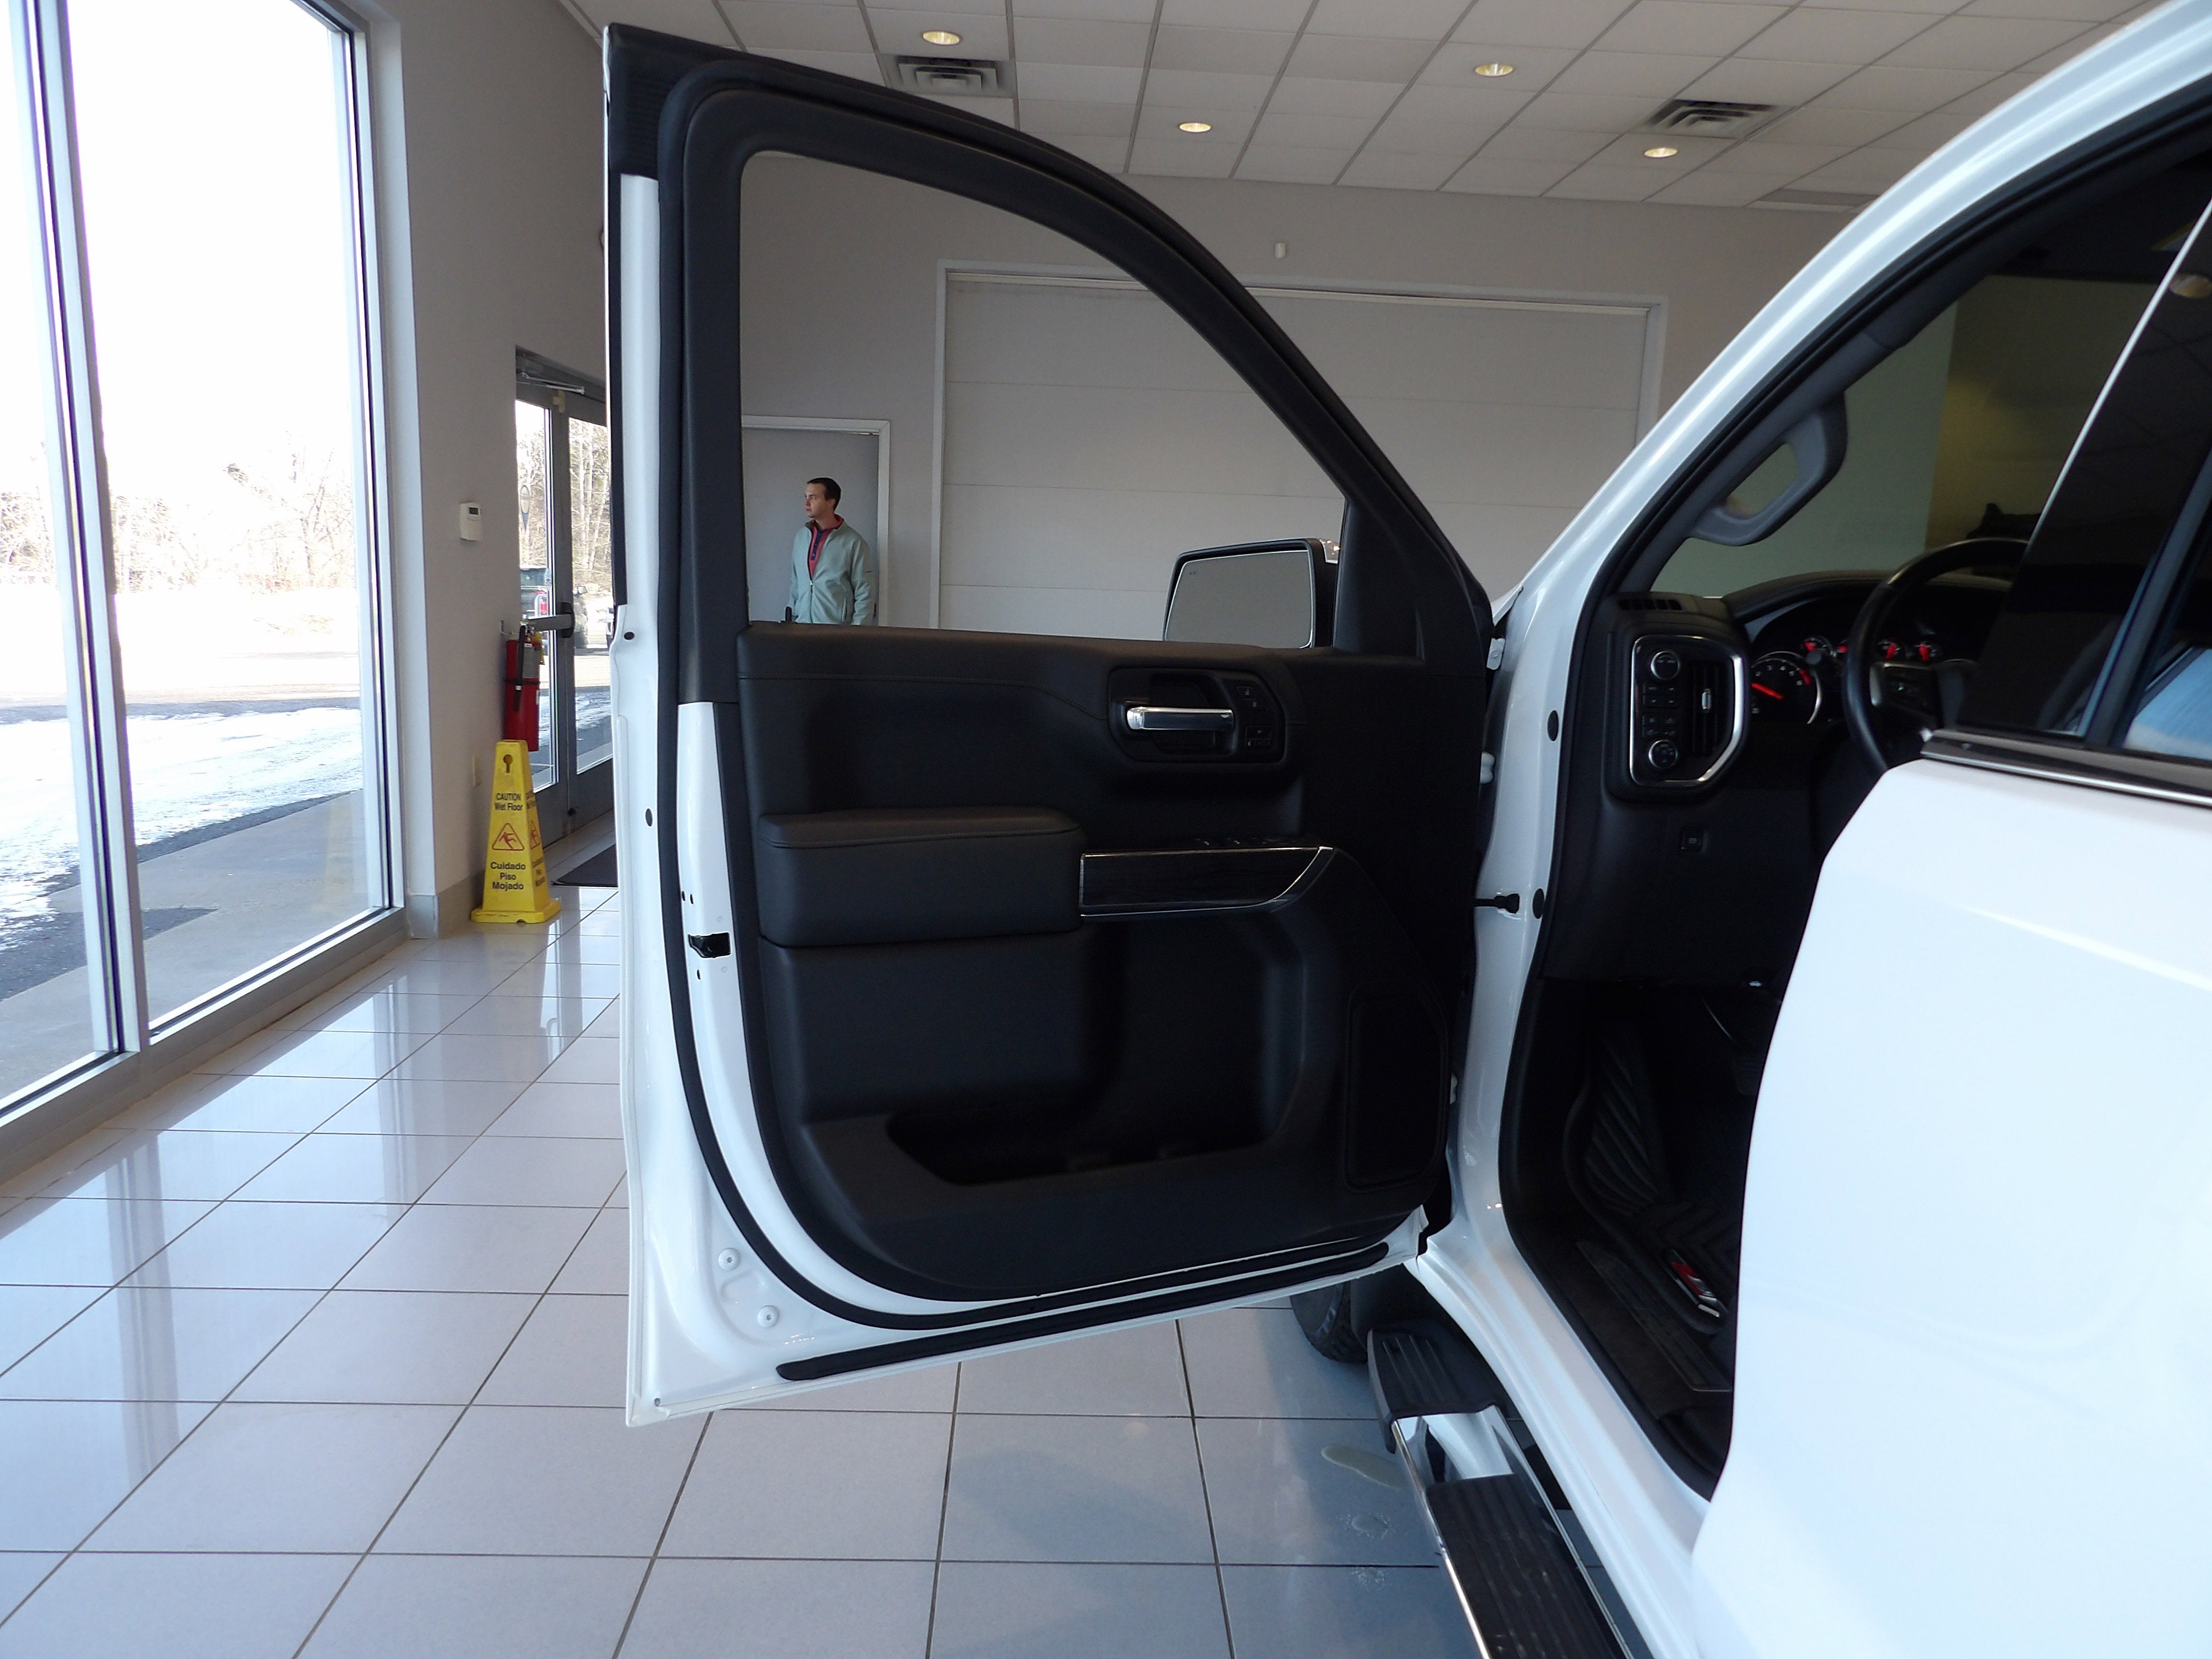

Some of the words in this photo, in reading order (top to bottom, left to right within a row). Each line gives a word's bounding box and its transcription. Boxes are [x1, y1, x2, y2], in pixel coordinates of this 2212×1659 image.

[496, 793, 521, 801] CAUTION
[494, 802, 506, 810] Wet
[507, 803, 523, 811] Floor
[491, 862, 526, 870] Cuidado
[492, 882, 524, 891] Mojado
